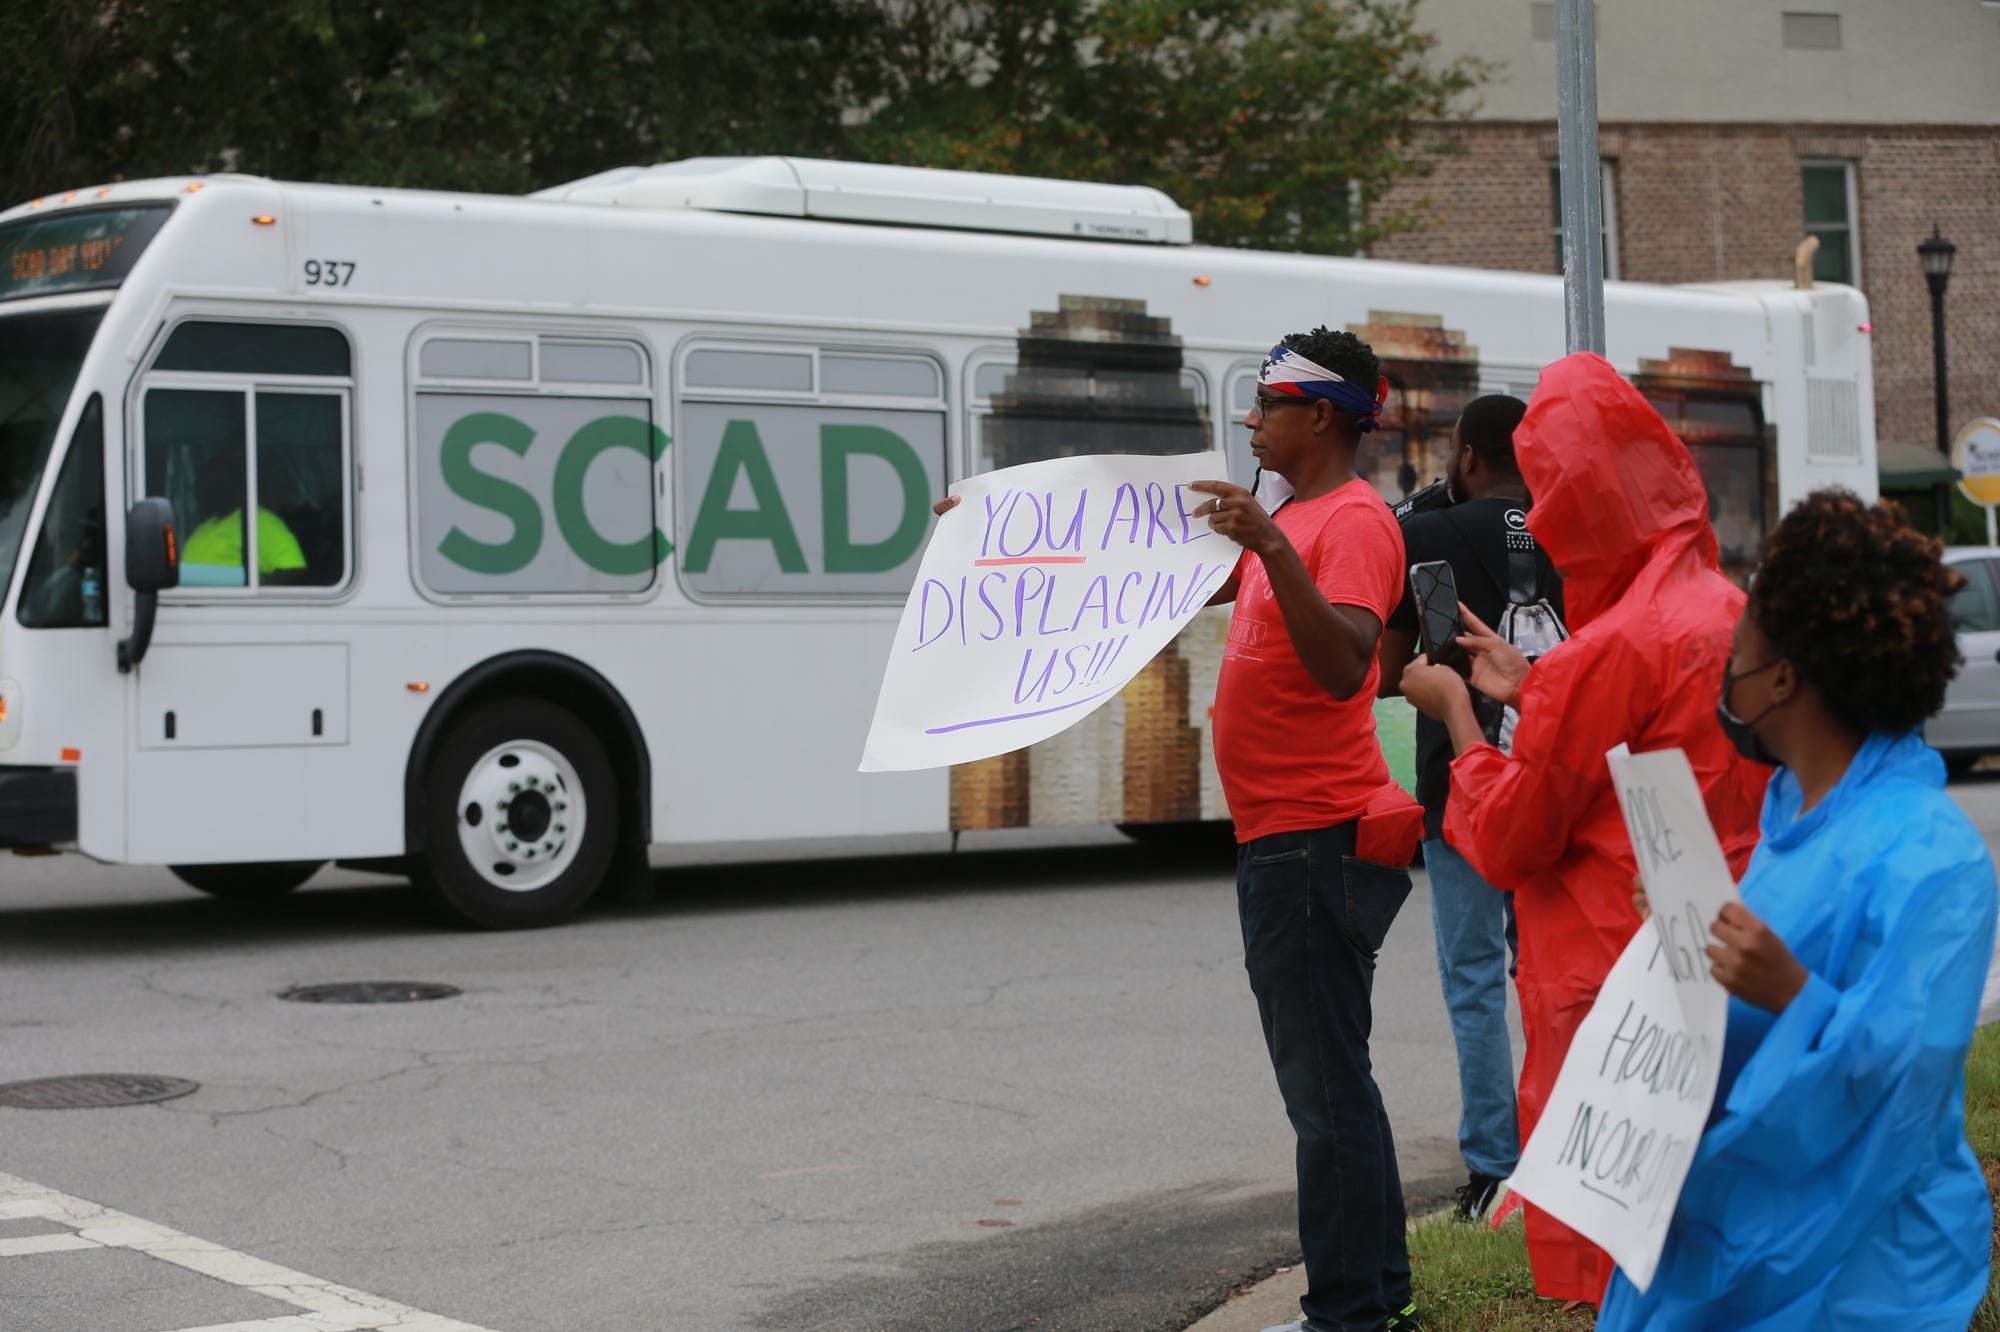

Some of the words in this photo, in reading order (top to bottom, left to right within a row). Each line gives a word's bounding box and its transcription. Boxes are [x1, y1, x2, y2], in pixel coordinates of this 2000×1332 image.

[304, 260, 356, 287] 937
[437, 411, 932, 577] SCAD
[981, 487, 1089, 558] YOU
[1100, 482, 1213, 551] ARE
[1396, 500, 1414, 518] PYLE
[911, 562, 1227, 653] DISPLACING
[1013, 634, 1129, 706] US!!!
[1556, 1101, 1608, 1170] IN
